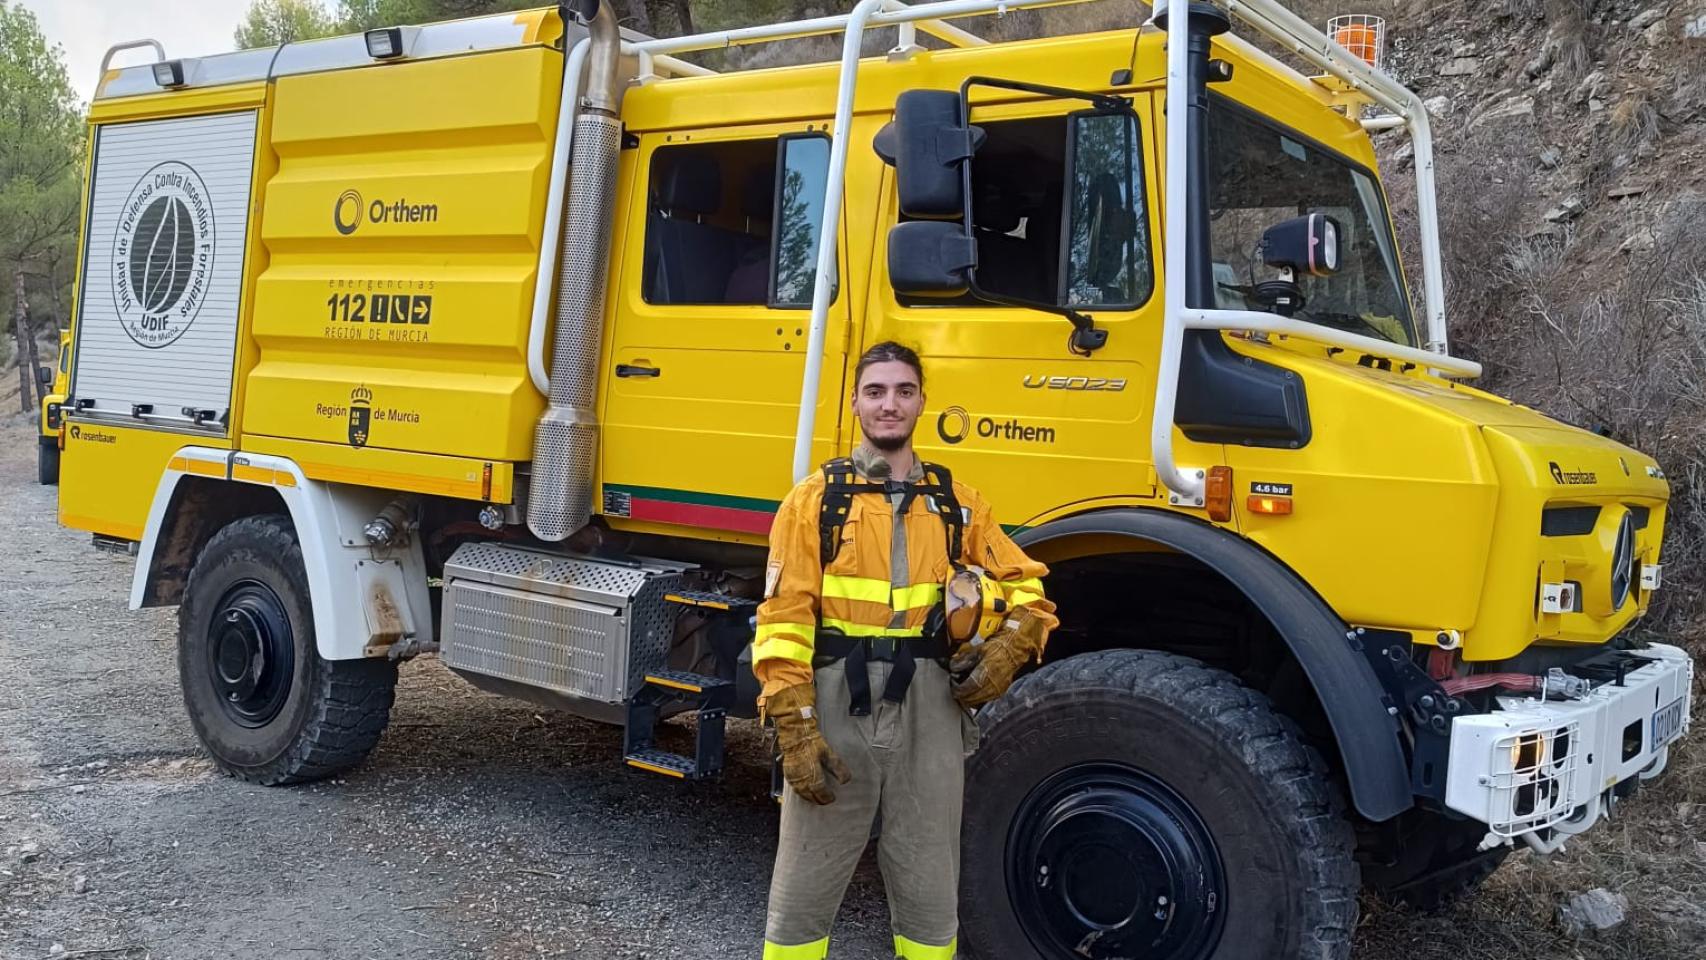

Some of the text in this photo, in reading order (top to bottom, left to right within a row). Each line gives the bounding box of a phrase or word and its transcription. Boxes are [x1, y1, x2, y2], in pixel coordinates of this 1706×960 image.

[369, 198, 438, 224] Orthem
[117, 171, 210, 317] Unidad de Defensa Contra Incendios Forestales
[329, 279, 435, 291] emergencias
[327, 293, 366, 322] 112
[141, 313, 169, 331] UDIF
[149, 331, 157, 342] de
[325, 326, 429, 342] REGIÓN DE MURCIA
[316, 402, 420, 424] Región de Murcia
[977, 417, 1056, 443] Orthem
[1255, 484, 1289, 494] 4.6 bar
